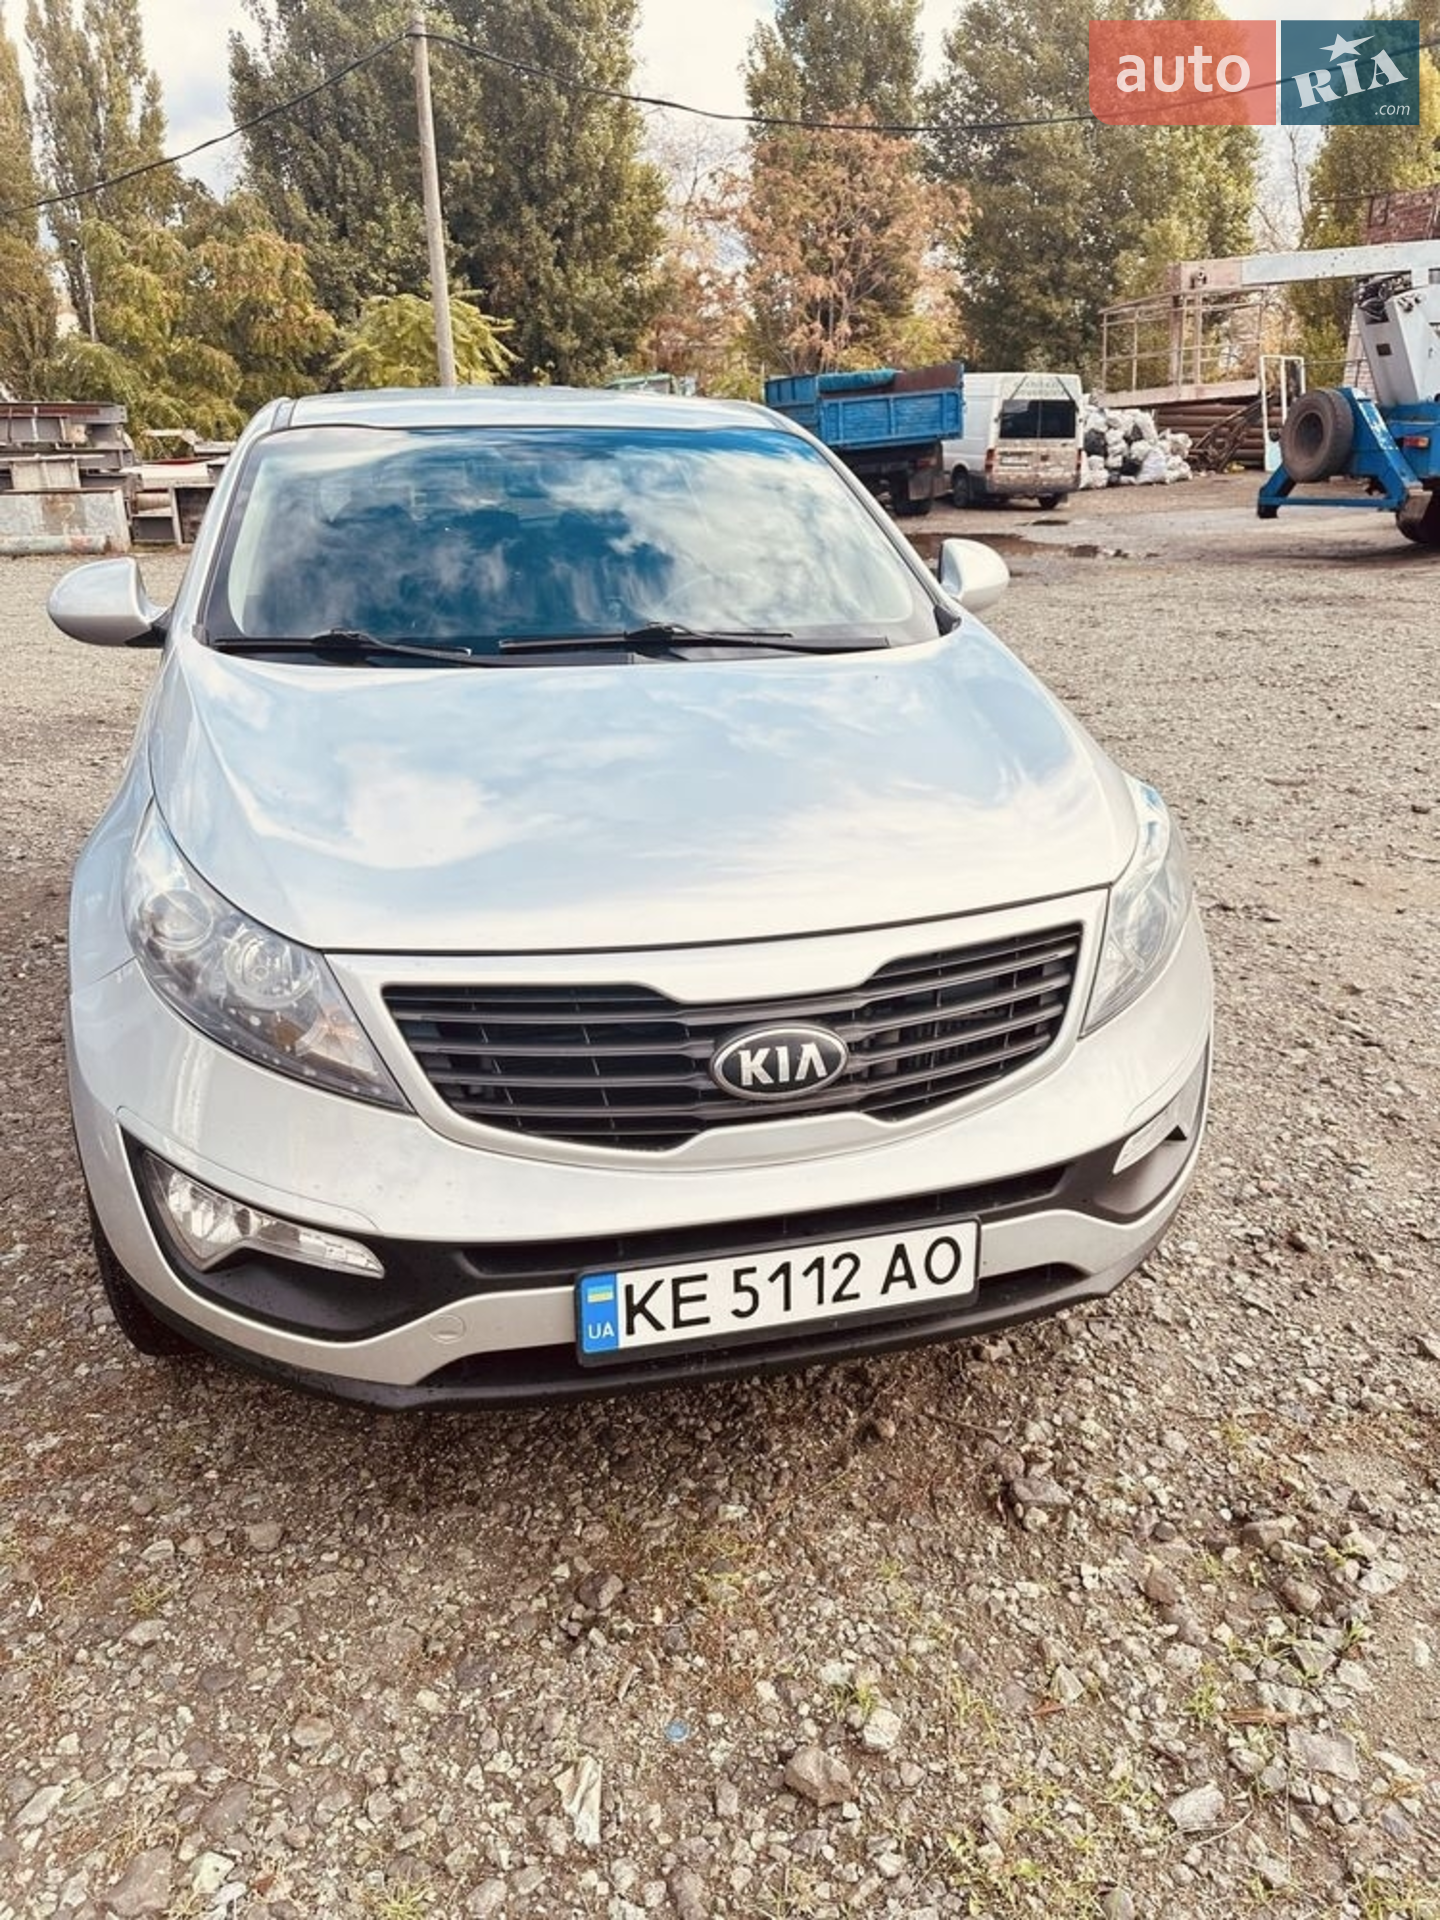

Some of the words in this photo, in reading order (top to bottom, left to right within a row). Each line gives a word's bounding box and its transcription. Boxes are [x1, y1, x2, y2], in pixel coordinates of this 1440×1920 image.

[738, 1042, 828, 1086] KIA
[624, 1273, 711, 1336] KE
[730, 1251, 861, 1319] 5112
[880, 1235, 962, 1294] AO
[588, 1322, 615, 1340] UA
